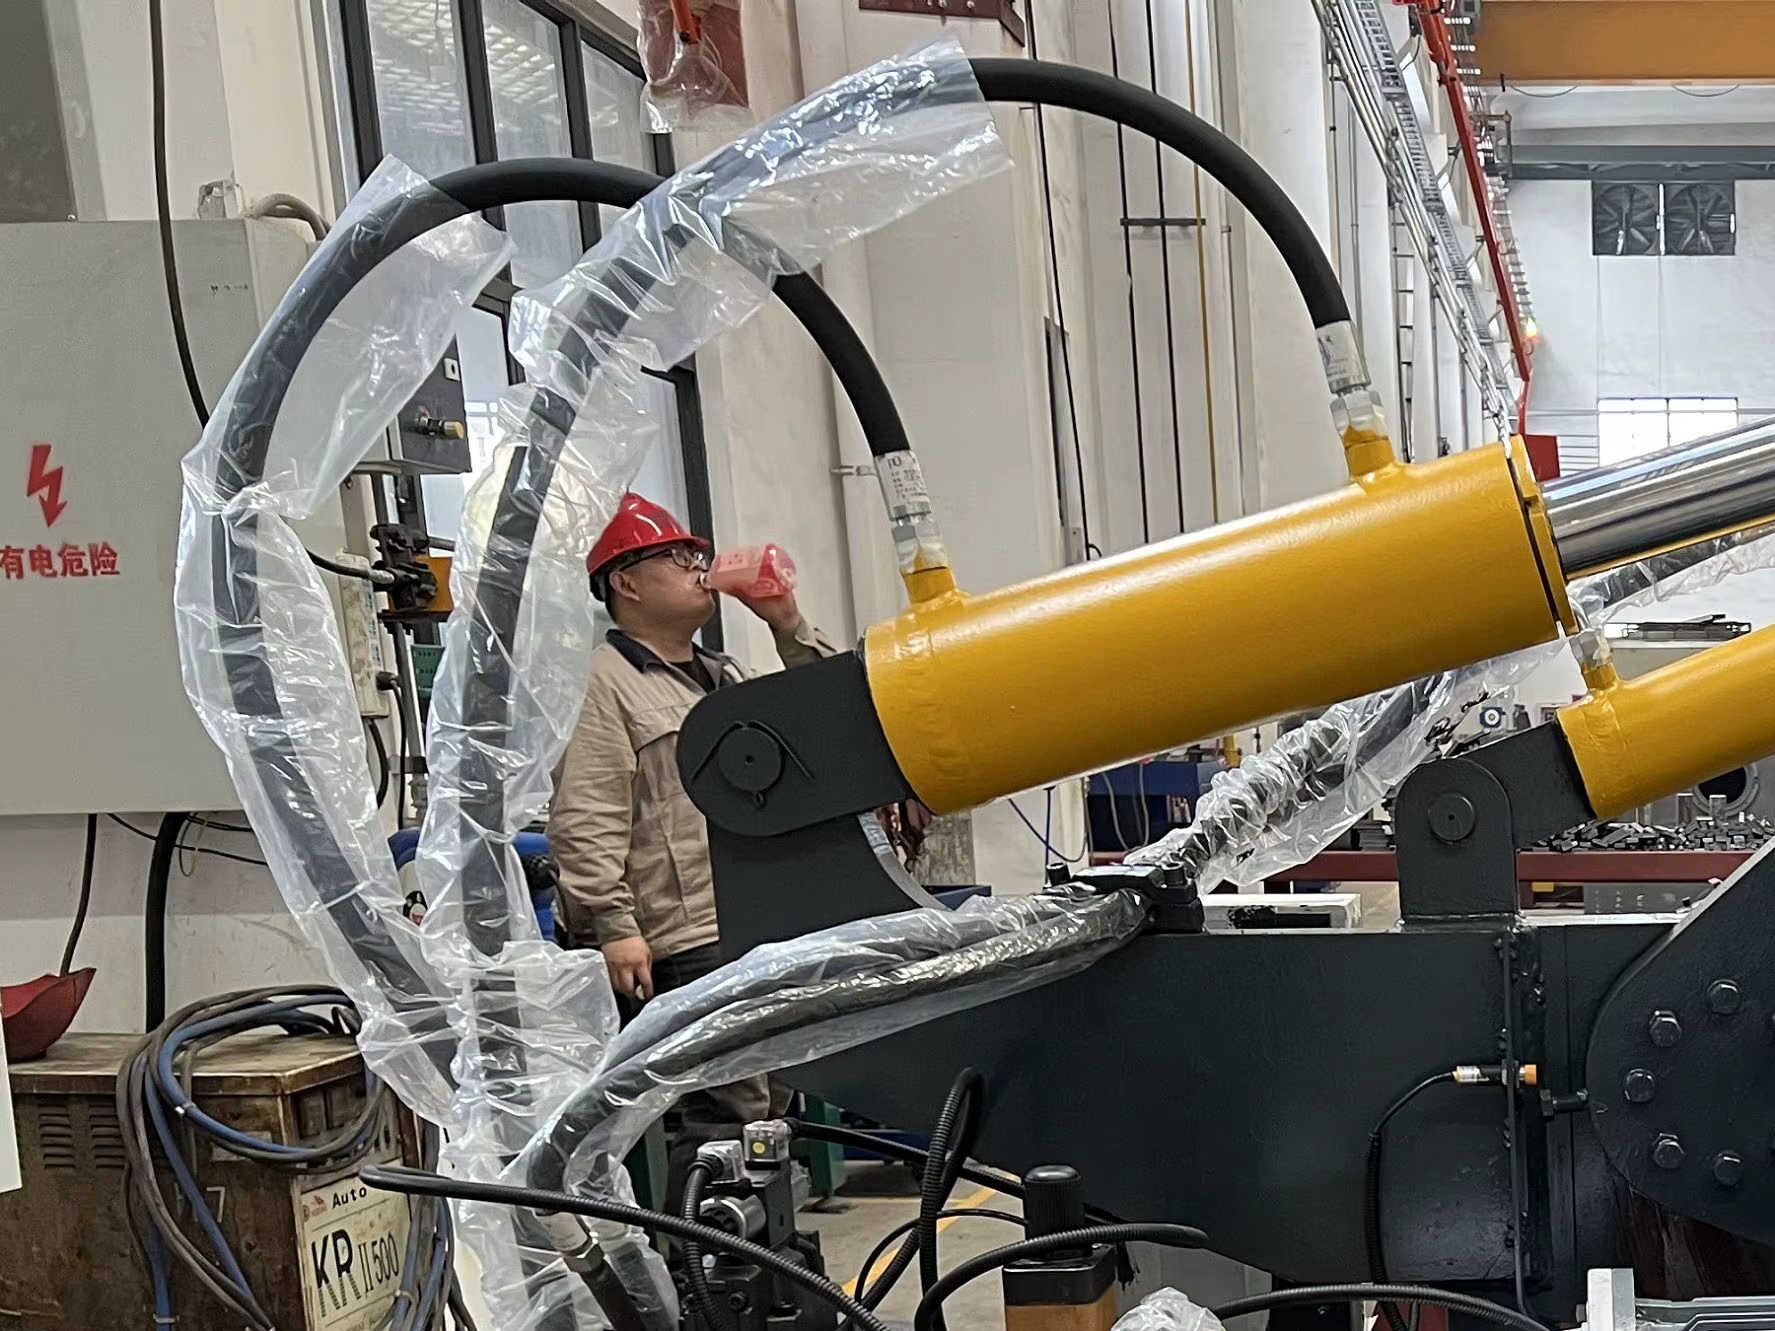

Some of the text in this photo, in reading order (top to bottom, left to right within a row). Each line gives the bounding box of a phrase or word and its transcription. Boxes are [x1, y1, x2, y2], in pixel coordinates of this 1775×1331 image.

[0, 541, 121, 580] 有电危险
[332, 1185, 368, 1210] Auto
[311, 1227, 361, 1318] KR
[372, 1232, 400, 1284] 500
